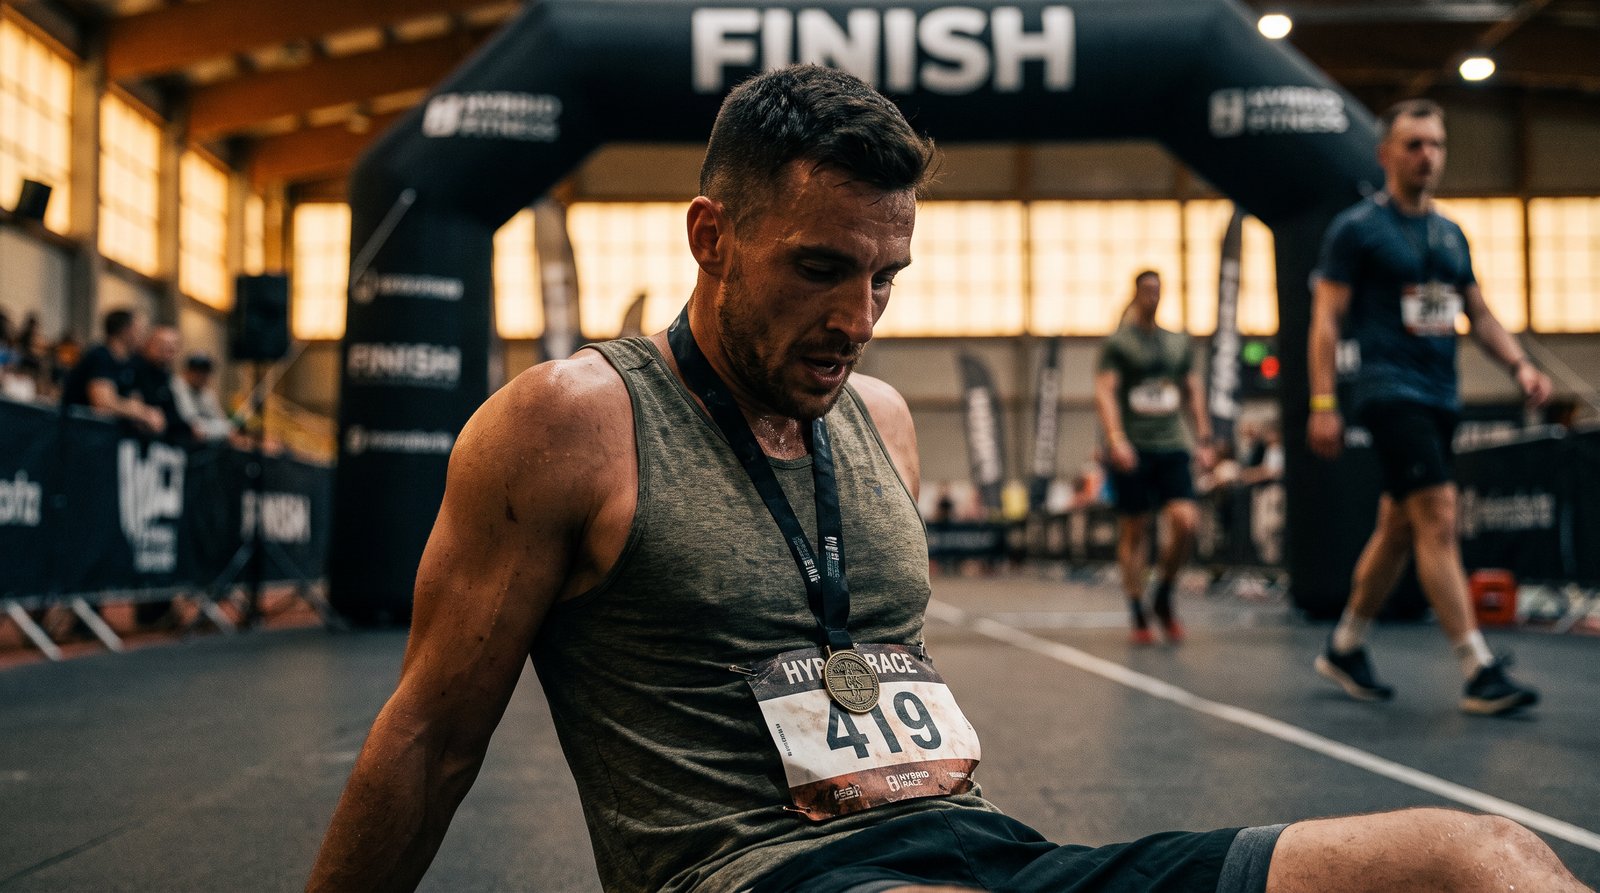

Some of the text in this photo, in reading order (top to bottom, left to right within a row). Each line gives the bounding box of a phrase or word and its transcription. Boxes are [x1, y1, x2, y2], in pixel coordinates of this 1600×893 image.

[692, 5, 1076, 96] FINISH
[348, 343, 462, 382] FINISH
[241, 491, 311, 542] FNISH
[864, 653, 918, 674] RACE
[826, 691, 942, 759] 419
[899, 770, 930, 781] HYBRID
[902, 779, 924, 788] RACE
